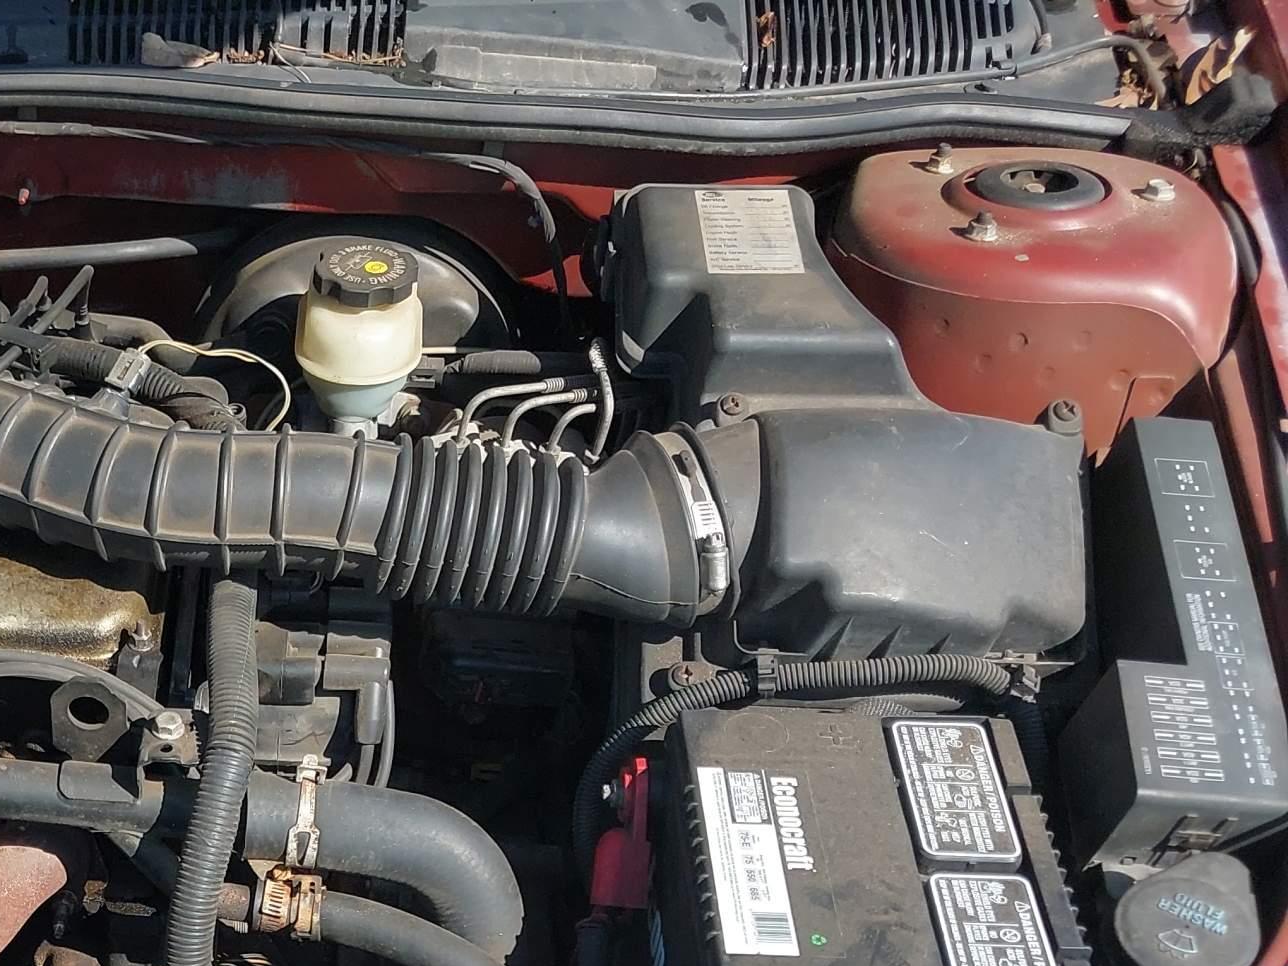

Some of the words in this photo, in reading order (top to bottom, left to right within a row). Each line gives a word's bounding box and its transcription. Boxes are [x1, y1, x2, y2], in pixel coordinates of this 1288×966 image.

[973, 754, 1006, 833] DANGER/POISON
[770, 776, 814, 871] Econocraft
[1157, 898, 1229, 936] WASHER
[1174, 892, 1225, 920] FLUID
